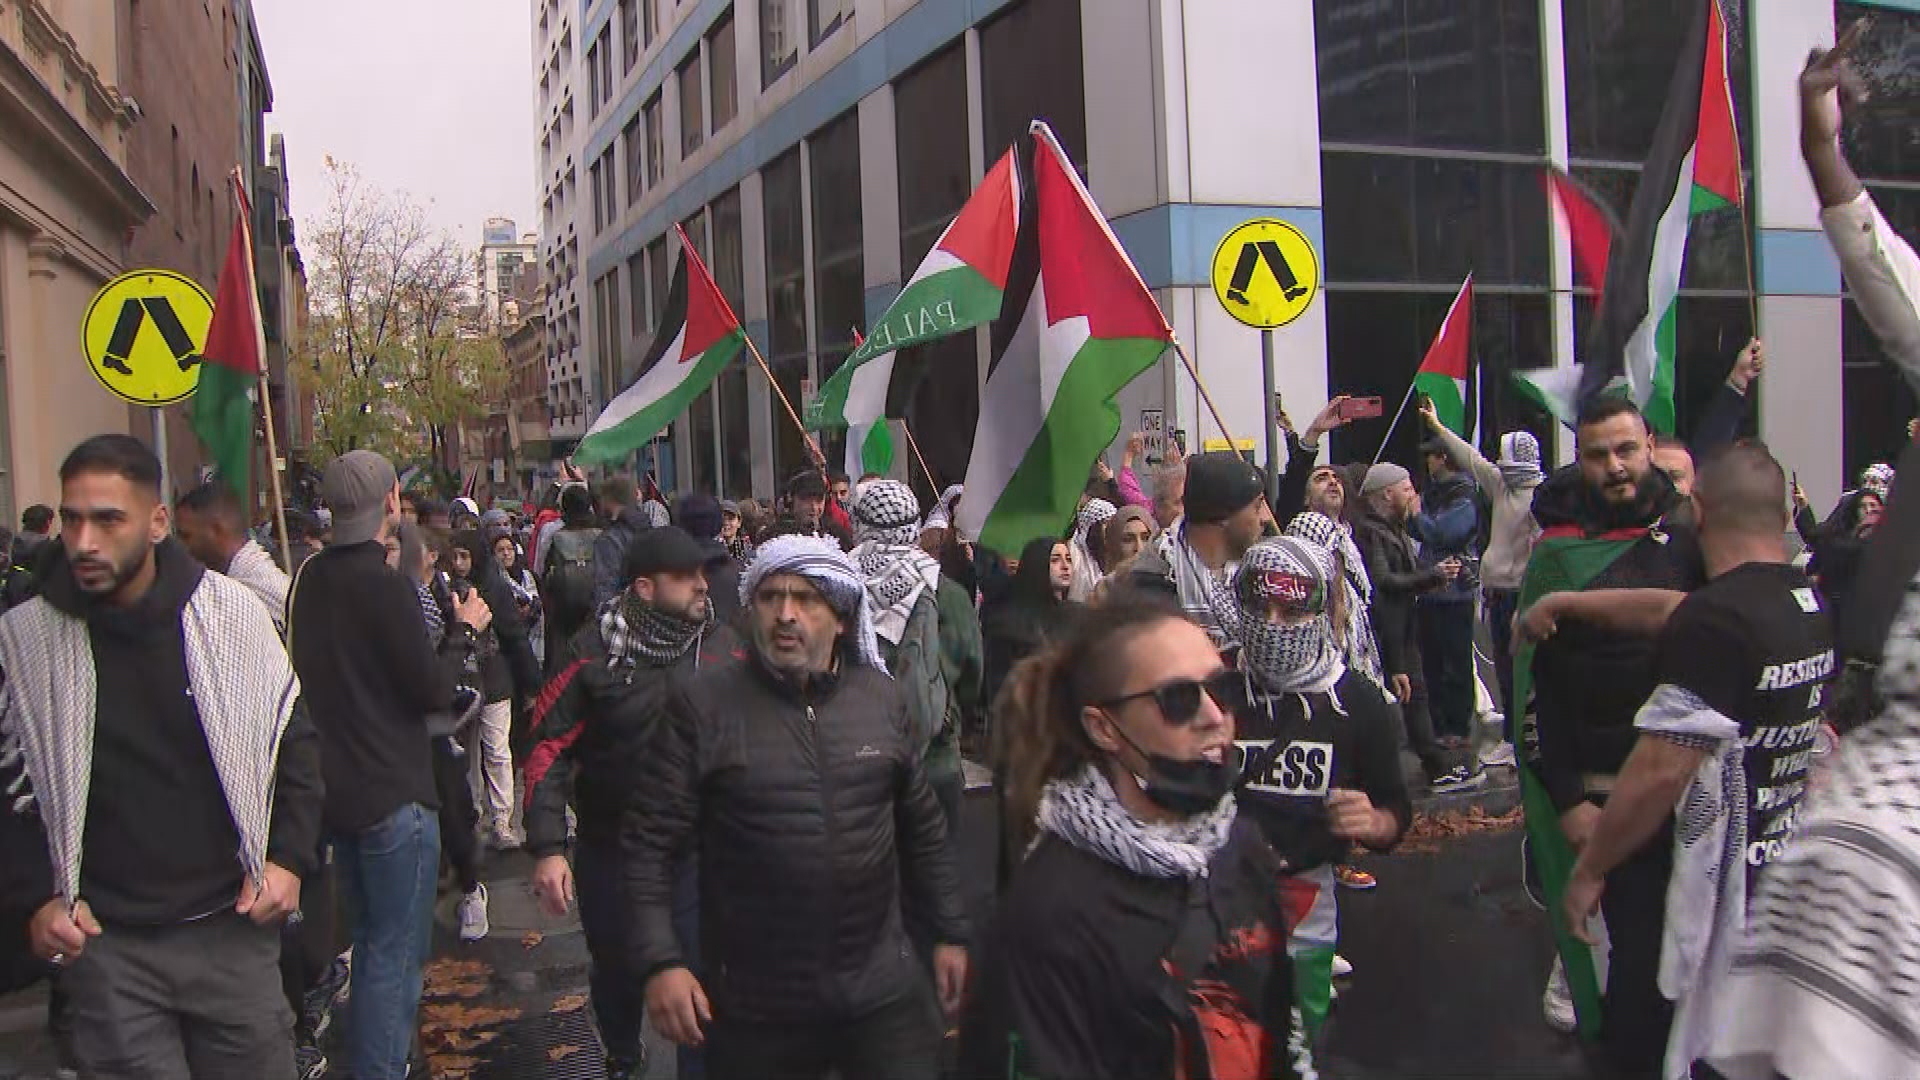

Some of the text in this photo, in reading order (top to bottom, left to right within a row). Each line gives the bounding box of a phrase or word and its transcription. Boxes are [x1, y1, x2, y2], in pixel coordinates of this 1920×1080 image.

[1144, 415, 1161, 431] ONE
[1143, 435, 1162, 450] WAY
[1237, 745, 1326, 790] RESS
